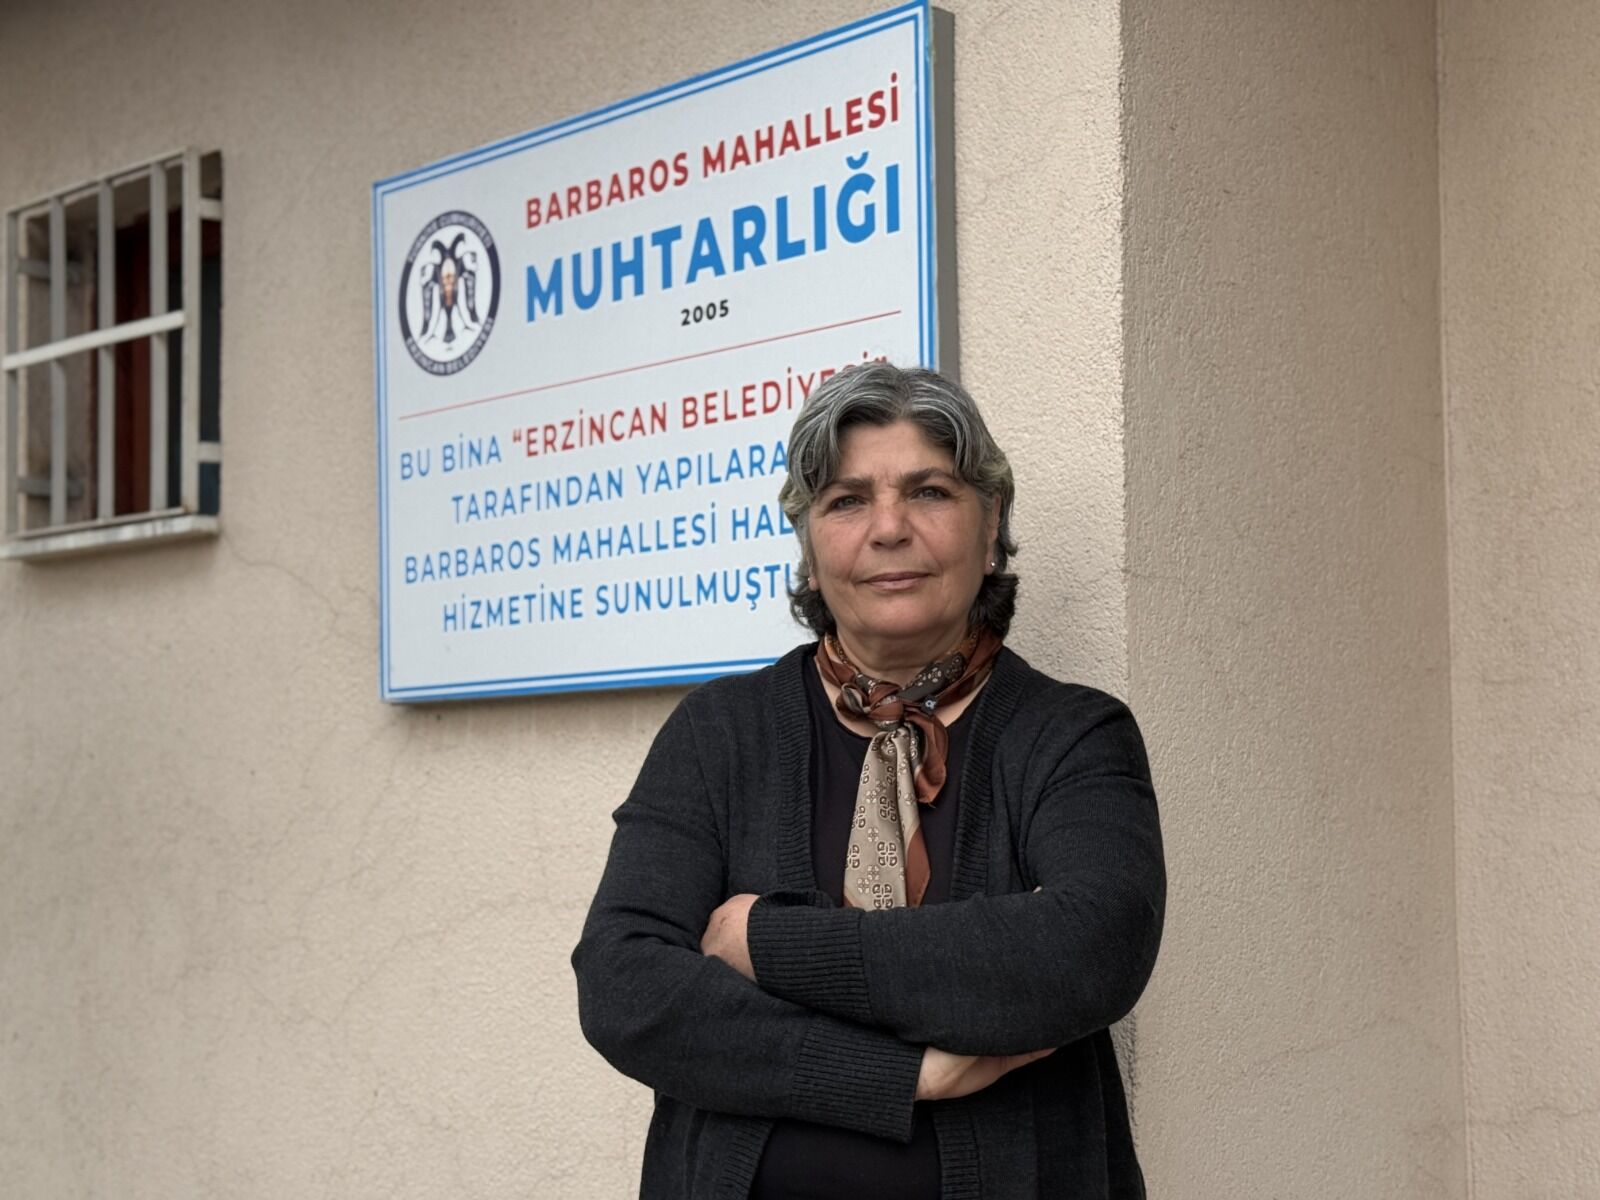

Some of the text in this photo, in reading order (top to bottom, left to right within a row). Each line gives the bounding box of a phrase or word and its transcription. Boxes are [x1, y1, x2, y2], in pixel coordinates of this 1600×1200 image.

[526, 72, 899, 230] BARBAROS MAHALLESİ
[525, 150, 902, 324] MUHTARLIĞI
[680, 299, 730, 327] 2005
[400, 446, 430, 481] BU
[442, 433, 501, 473] BİNA
[452, 439, 789, 525] TARAFINDAN YAPILARA
[405, 501, 796, 584] BARBAROS MAHALLESİ HAL
[443, 586, 583, 633] HİZMETİNE
